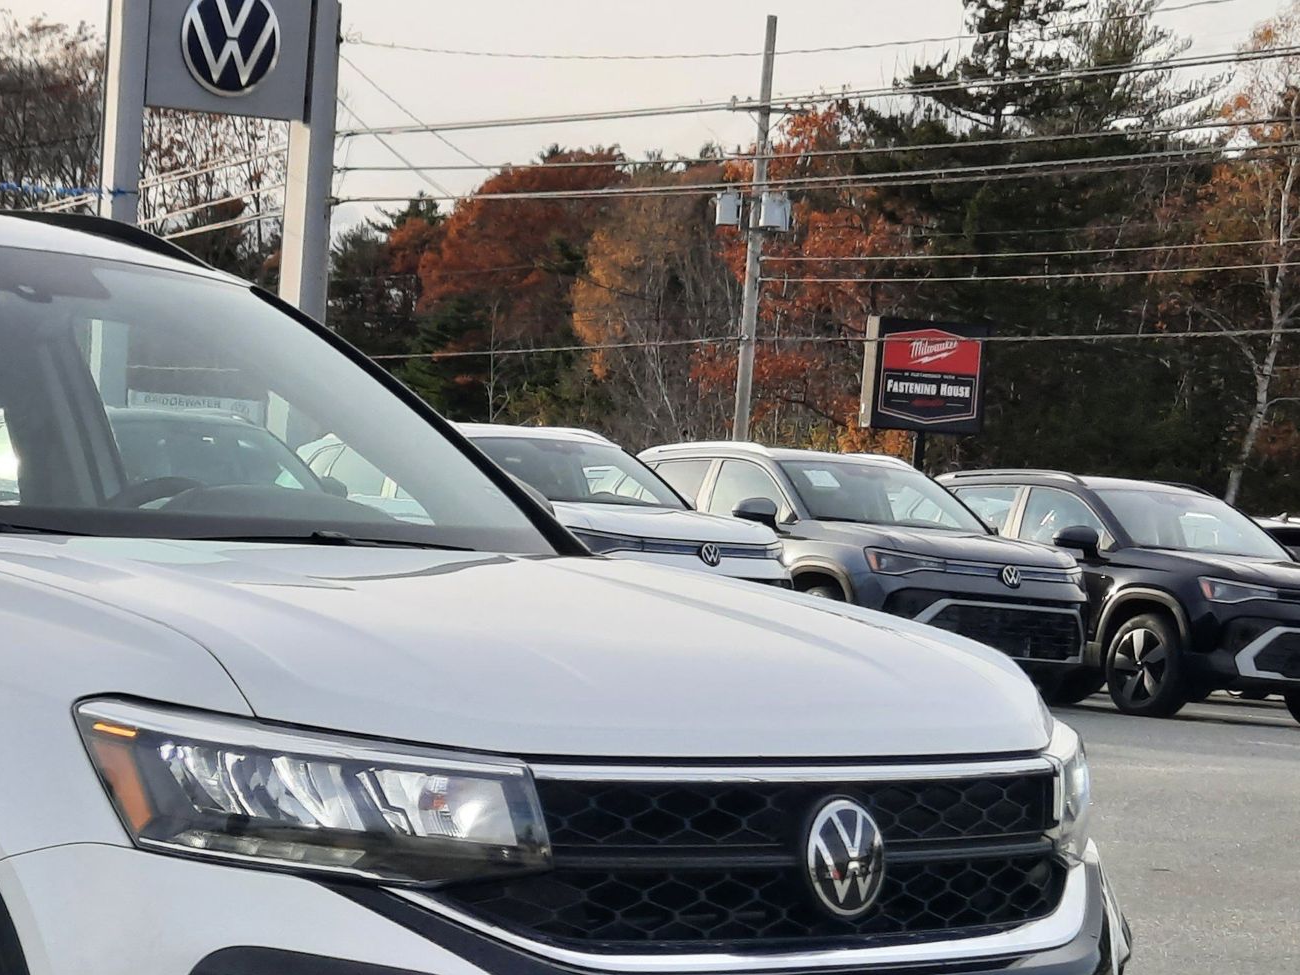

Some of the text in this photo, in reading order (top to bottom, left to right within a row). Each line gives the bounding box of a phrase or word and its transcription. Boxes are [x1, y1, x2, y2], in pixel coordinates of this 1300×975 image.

[886, 379, 970, 398] FASTENING HOUSE
[807, 799, 884, 916] VW
